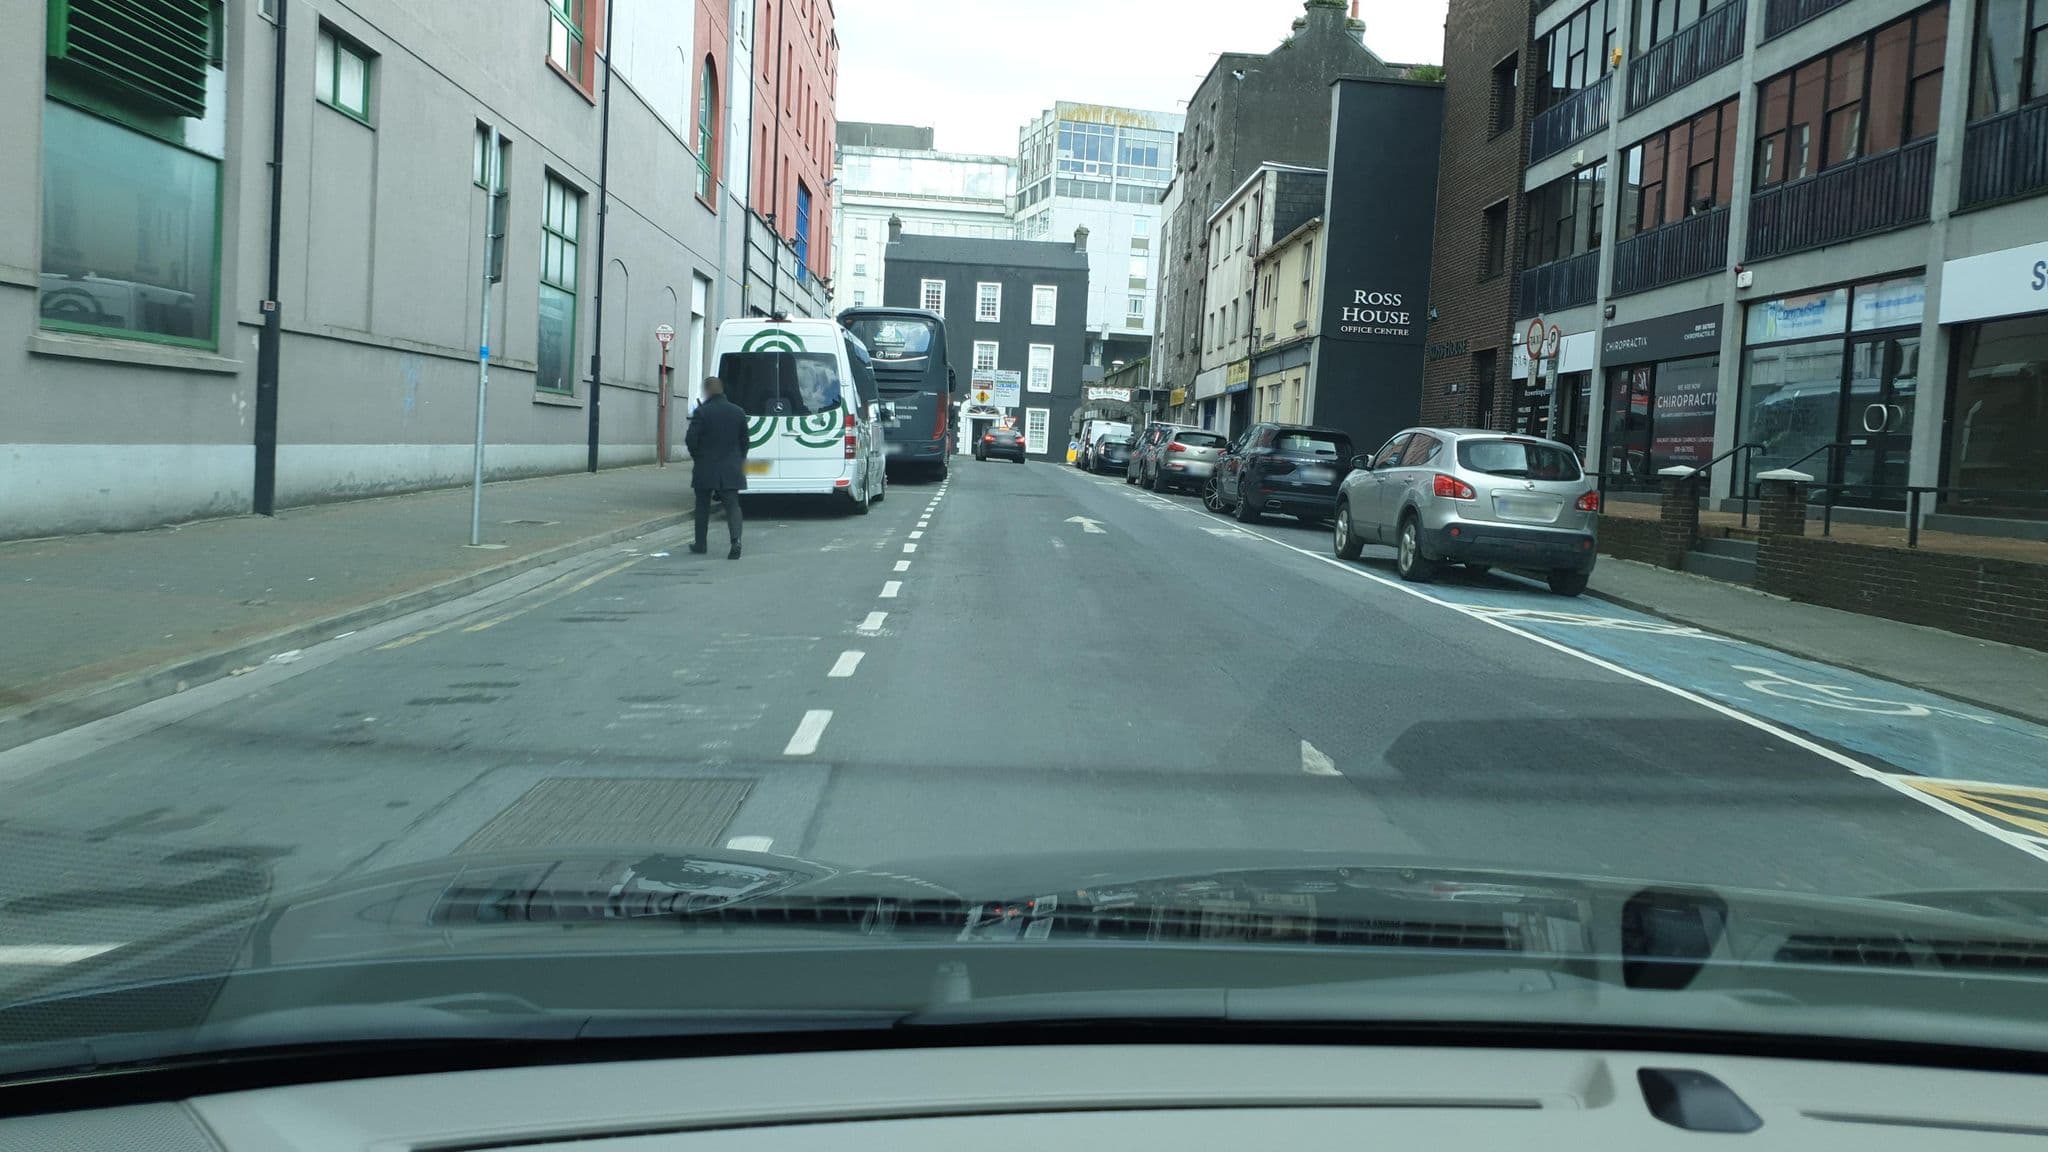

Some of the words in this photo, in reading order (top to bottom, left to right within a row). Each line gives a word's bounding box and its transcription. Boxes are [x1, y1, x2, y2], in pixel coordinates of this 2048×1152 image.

[2031, 260, 2048, 291] S
[1353, 289, 1402, 306] ROSS
[1341, 306, 1410, 325] HOUSE
[1340, 325, 1373, 334] OFFICE
[1374, 327, 1410, 336] CENTRE
[1605, 336, 1648, 352] CHIROPRACTIX
